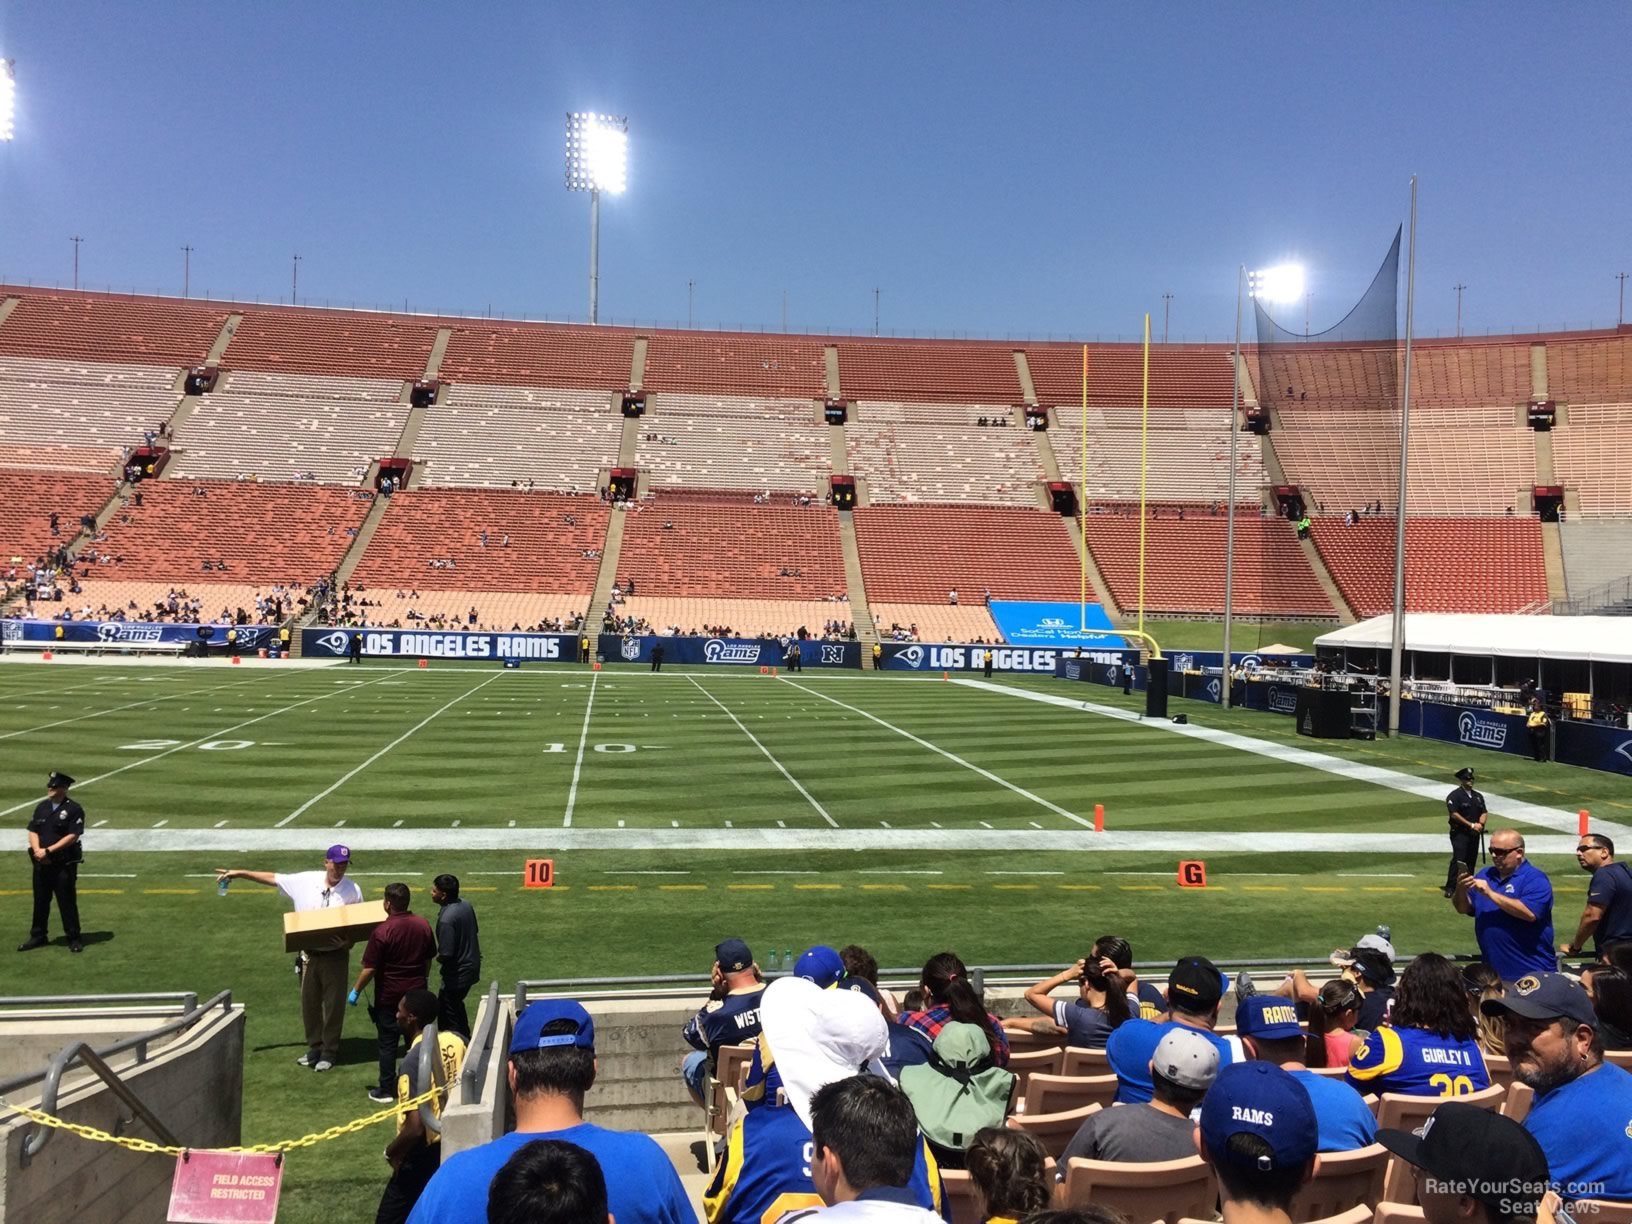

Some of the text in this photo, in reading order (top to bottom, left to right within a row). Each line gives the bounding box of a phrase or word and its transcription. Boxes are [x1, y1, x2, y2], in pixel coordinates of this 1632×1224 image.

[400, 635, 490, 657] ANGELES
[497, 637, 559, 658] RAMS
[704, 640, 760, 663] Rams
[930, 648, 965, 668] LOS
[1459, 712, 1507, 748] Rams
[543, 743, 636, 753] 10
[529, 863, 550, 882] 10
[1184, 863, 1203, 884] G
[1262, 1006, 1297, 1025] RAMS
[1422, 1048, 1471, 1066] GURLEY II
[1232, 1106, 1273, 1126] RAMS
[213, 1174, 275, 1187] FIELD ACCESS
[210, 1188, 265, 1200] RESTRICTED
